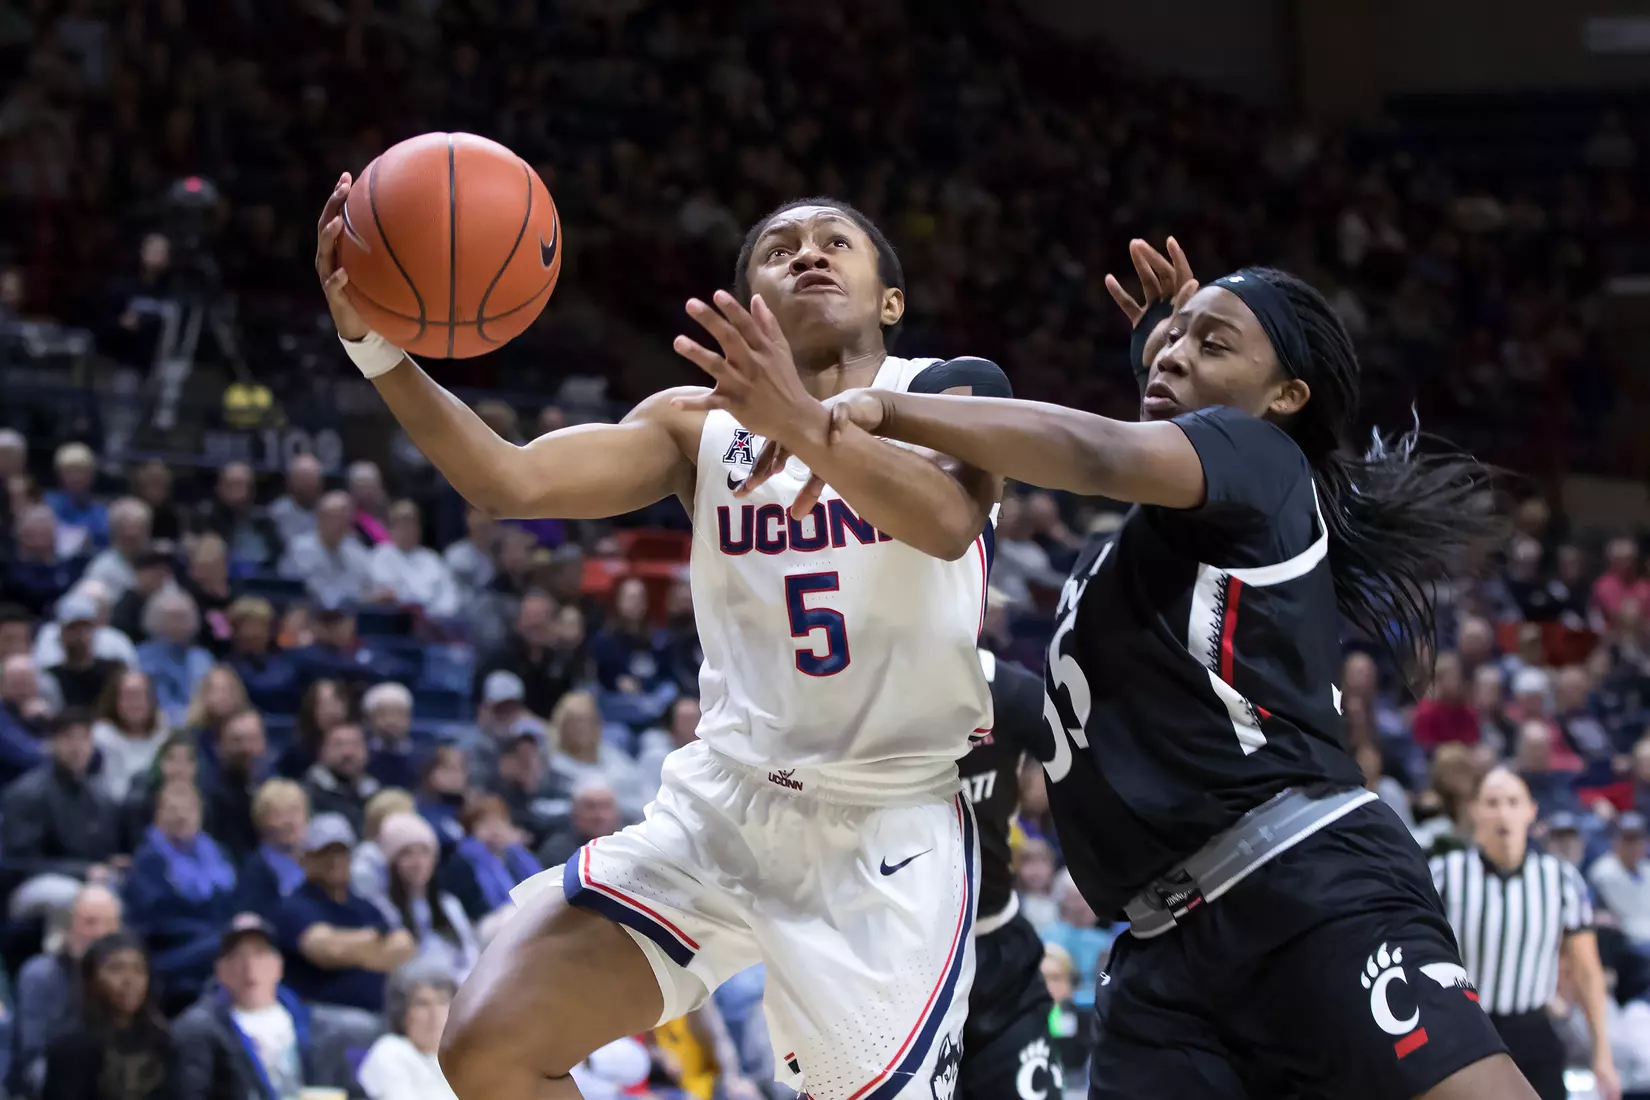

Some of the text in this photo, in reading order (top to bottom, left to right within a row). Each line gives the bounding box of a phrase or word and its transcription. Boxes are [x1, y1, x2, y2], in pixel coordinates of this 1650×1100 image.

[717, 498, 893, 555] UCON
[785, 571, 850, 677] 5
[768, 771, 803, 791] UCONN
